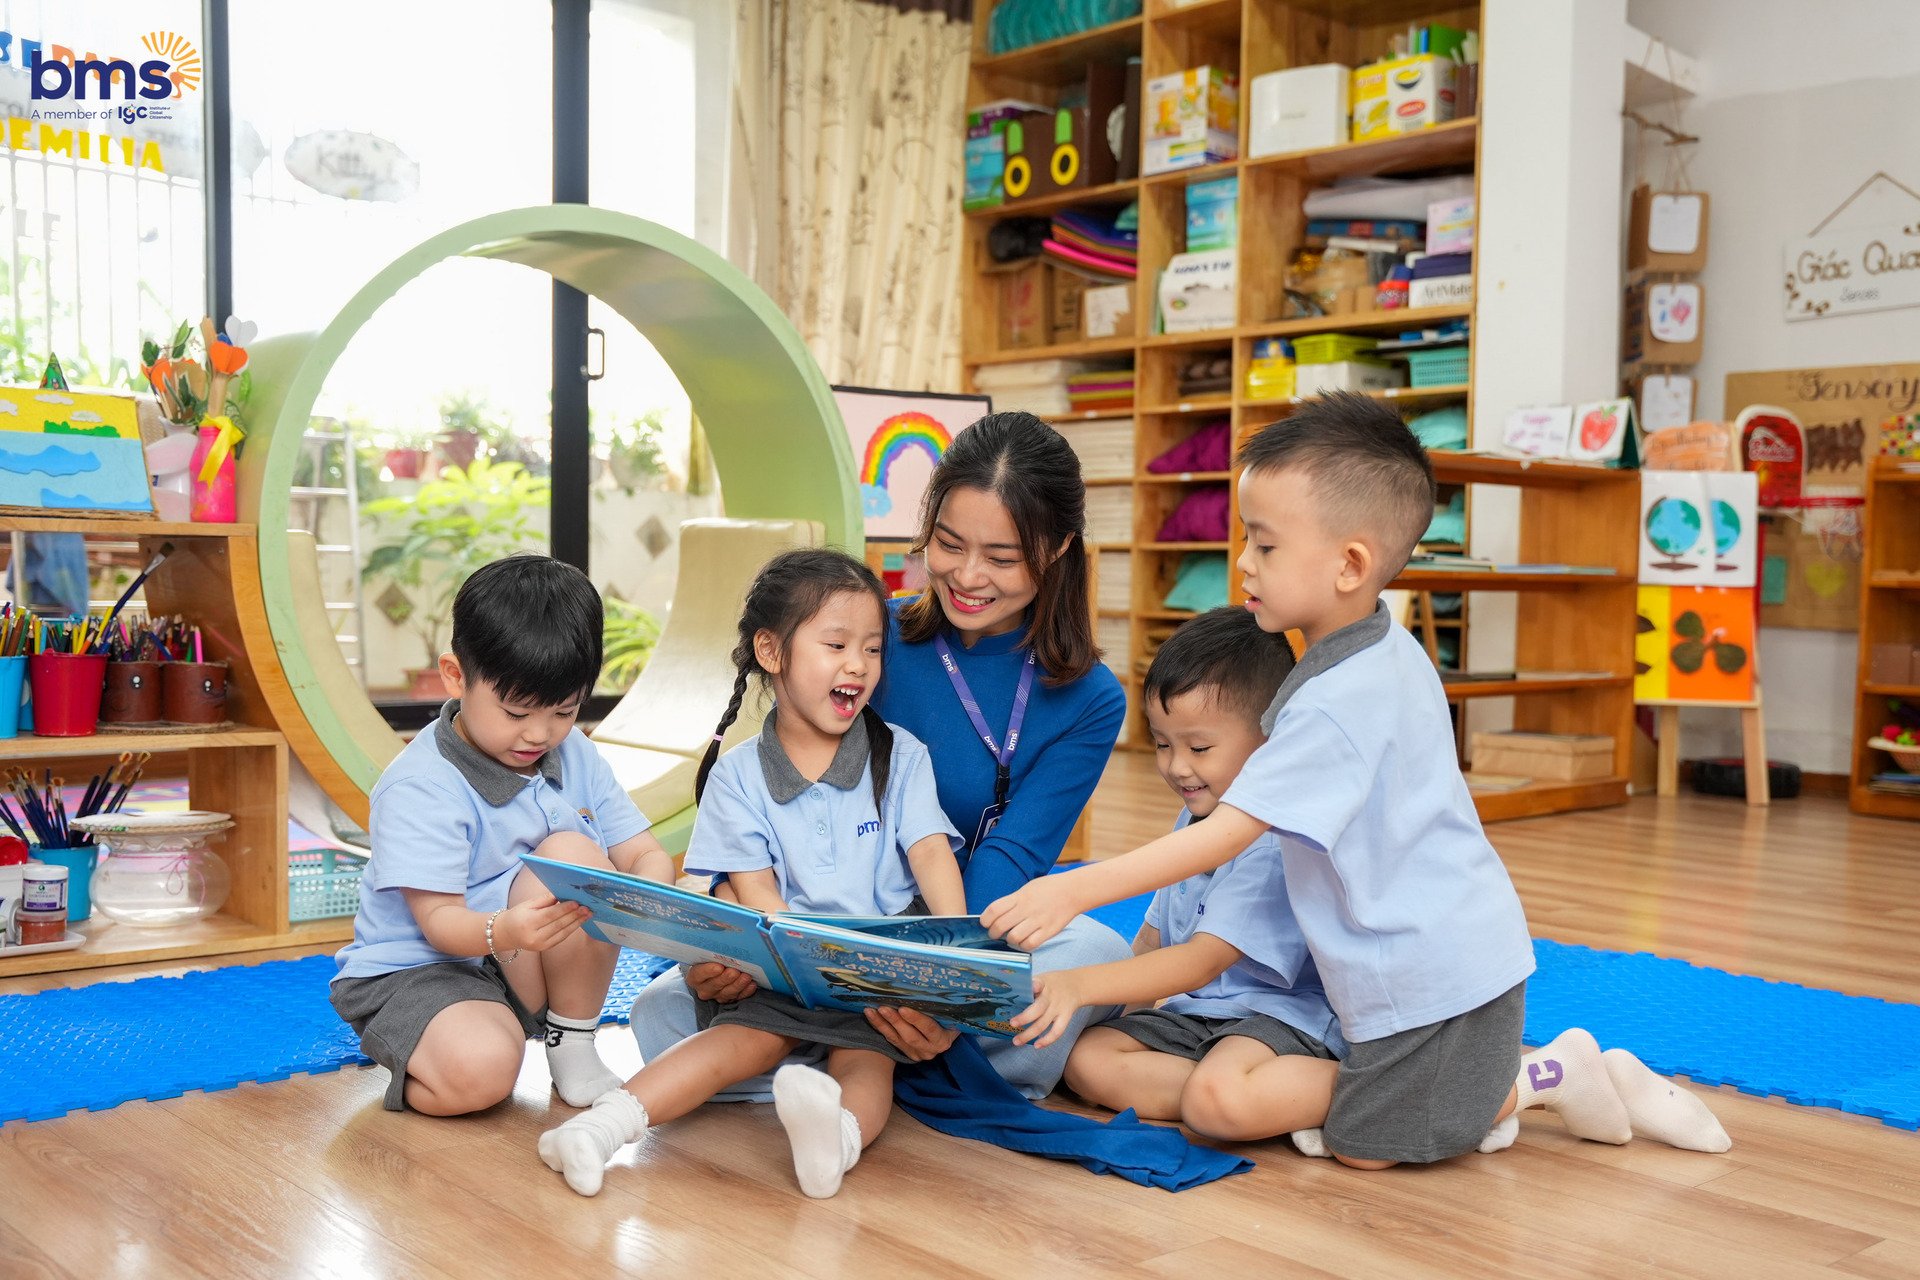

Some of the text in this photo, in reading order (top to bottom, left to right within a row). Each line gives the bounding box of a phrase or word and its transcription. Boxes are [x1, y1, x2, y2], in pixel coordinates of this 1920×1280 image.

[1798, 247, 1853, 284] Giác
[1799, 371, 1920, 413] Sensory
[941, 653, 954, 672] bms
[1028, 649, 1036, 664] bm
[984, 735, 999, 751] bms
[1007, 732, 1018, 751] bms
